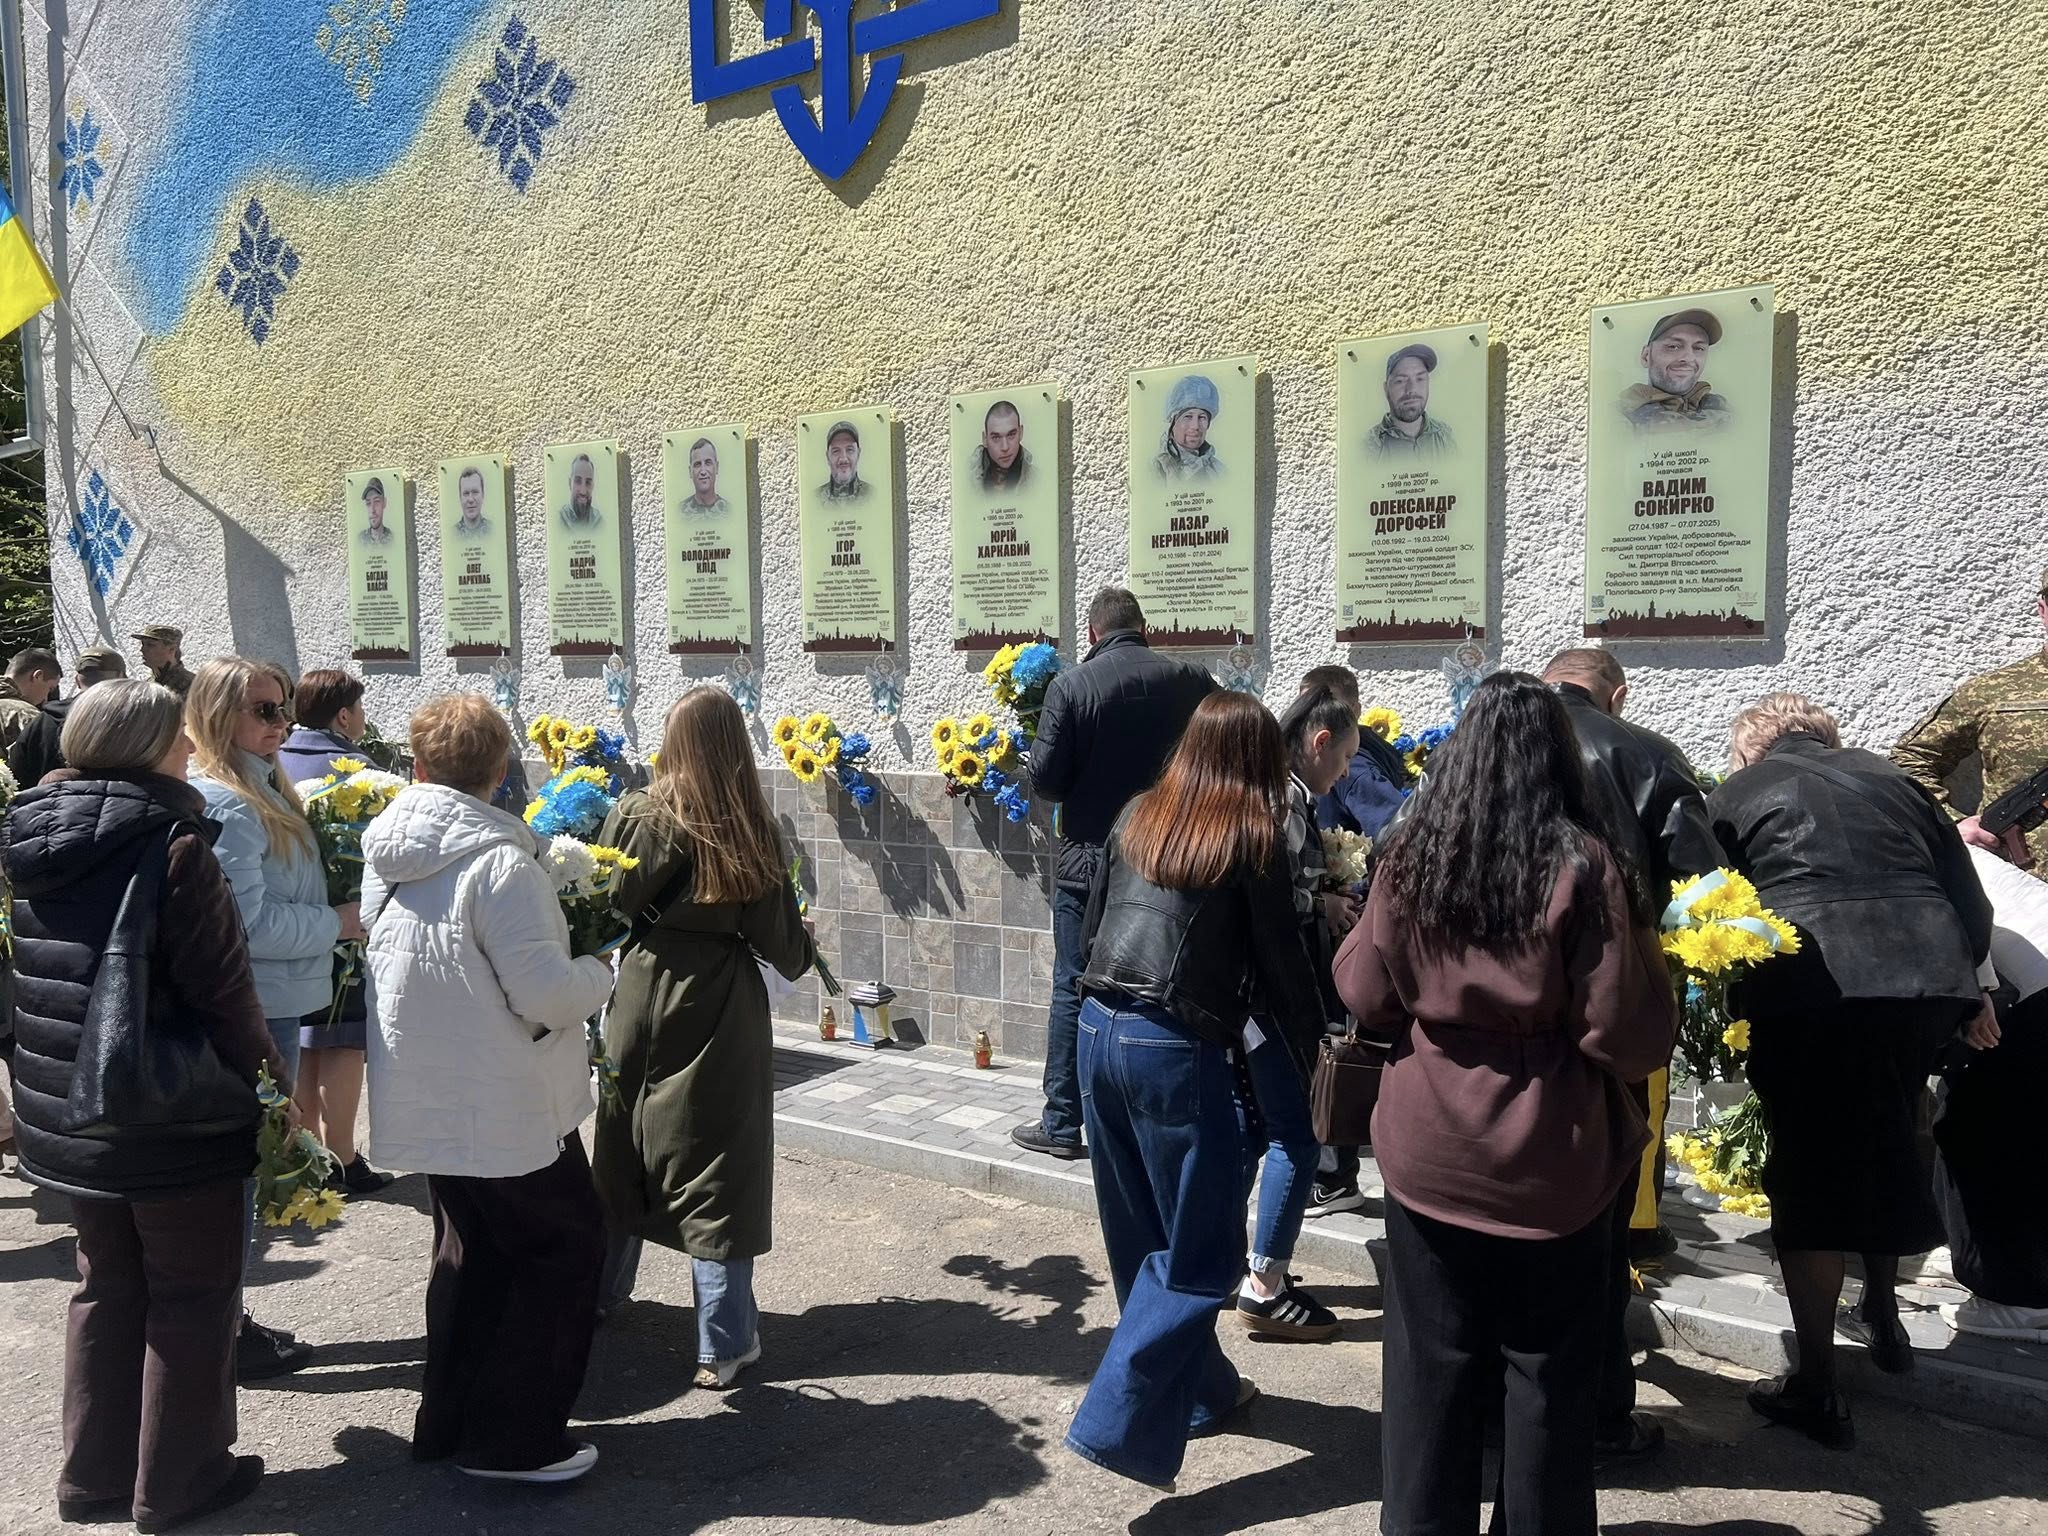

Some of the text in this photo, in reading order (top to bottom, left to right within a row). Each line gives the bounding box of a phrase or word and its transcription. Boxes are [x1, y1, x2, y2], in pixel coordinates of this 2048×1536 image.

[1661, 451, 1673, 459] цій
[1675, 449, 1697, 458] школі
[1647, 460, 1664, 468] 1994
[1657, 467, 1692, 475] навчався
[1643, 478, 1706, 498] ВАДИМ
[1371, 496, 1456, 518] ОЛЕКСАНДР
[1635, 496, 1714, 516] СОКИРКО
[1171, 516, 1209, 530] НАЗАР
[1375, 512, 1445, 534] ДОРОФЕЙ
[1628, 522, 1668, 532] (27.04.1987
[1678, 519, 1720, 528] 07.07.2025)
[991, 528, 1016, 542] ЮРІЙ
[1152, 528, 1228, 549] КЕРНИЦЬКИЙ
[1648, 533, 1679, 542] України,
[1682, 530, 1736, 540] доброволець,
[837, 540, 854, 552] ІГОР
[978, 541, 1030, 557] ХАРКАВИЙ
[1601, 544, 1633, 553] старший
[1665, 542, 1683, 550] 102-ї
[1685, 540, 1716, 549] окремої
[1718, 539, 1751, 548] бригади
[682, 549, 730, 562] ВОЛОДИМИР
[832, 554, 861, 567] ХОДАН
[1636, 550, 1694, 560] територіальної
[1695, 549, 1729, 558] оборони
[1640, 560, 1669, 569] Дмитра
[1671, 558, 1718, 567] Вітовського.
[1606, 571, 1638, 579] Героїчно
[1671, 569, 1683, 577] під
[1702, 576, 1743, 584] Малинівка
[1606, 587, 1658, 596] Пологівського
[1678, 585, 1723, 594] Запорізької
[1724, 584, 1741, 592] обл.
